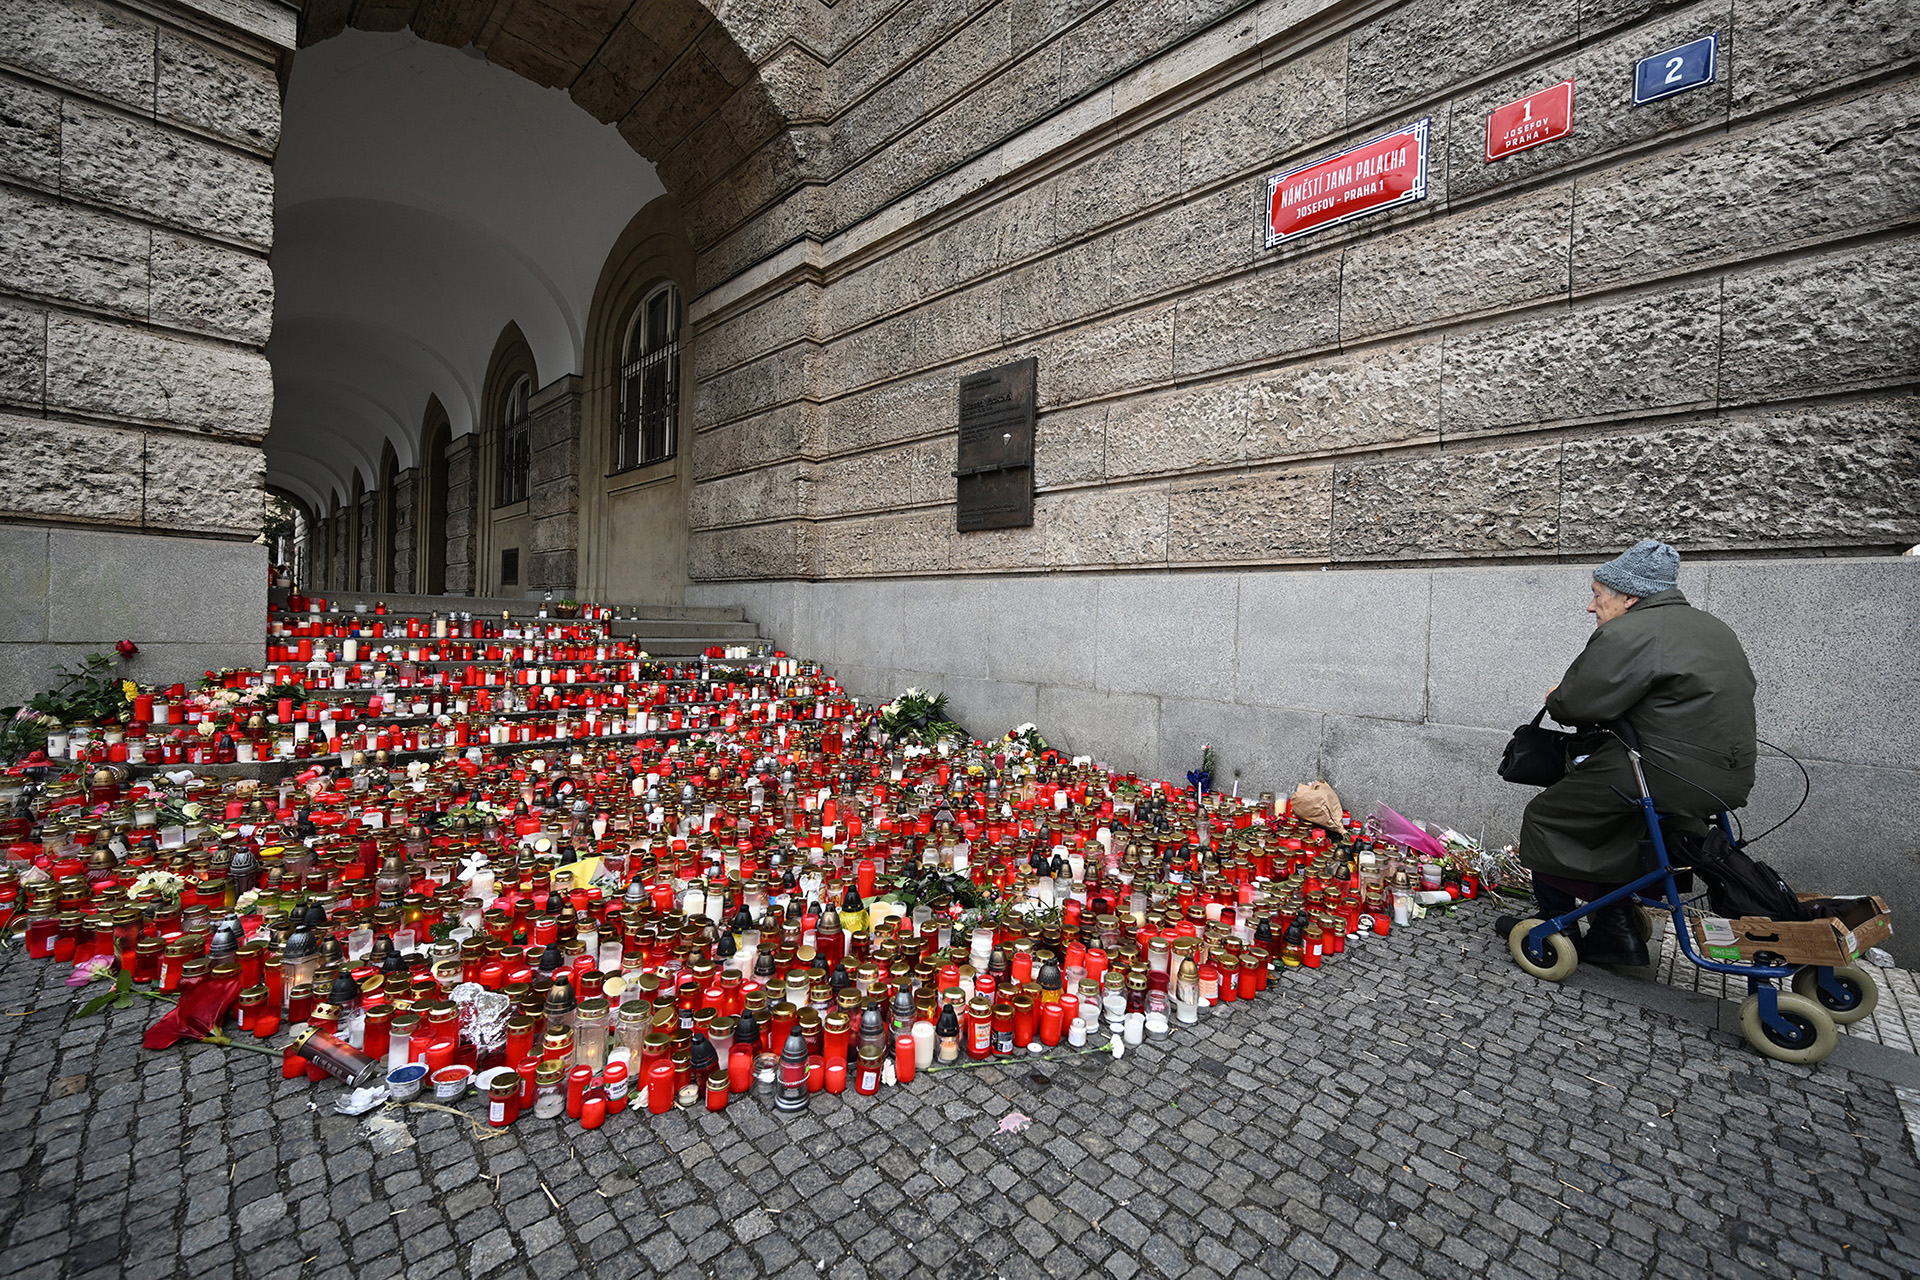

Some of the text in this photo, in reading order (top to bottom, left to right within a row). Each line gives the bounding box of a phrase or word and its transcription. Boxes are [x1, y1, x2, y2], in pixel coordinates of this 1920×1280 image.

[1664, 56, 1684, 85] 2
[1523, 100, 1532, 122] 1
[1504, 117, 1549, 139] JOSEFOV
[1505, 126, 1549, 149] PRAHA 1
[1281, 147, 1406, 208] NÁMĚSTÍ JANA PALACHA
[1296, 196, 1335, 219] JOSEFOV
[1344, 183, 1377, 203] PRAHA
[1379, 180, 1384, 191] 1
